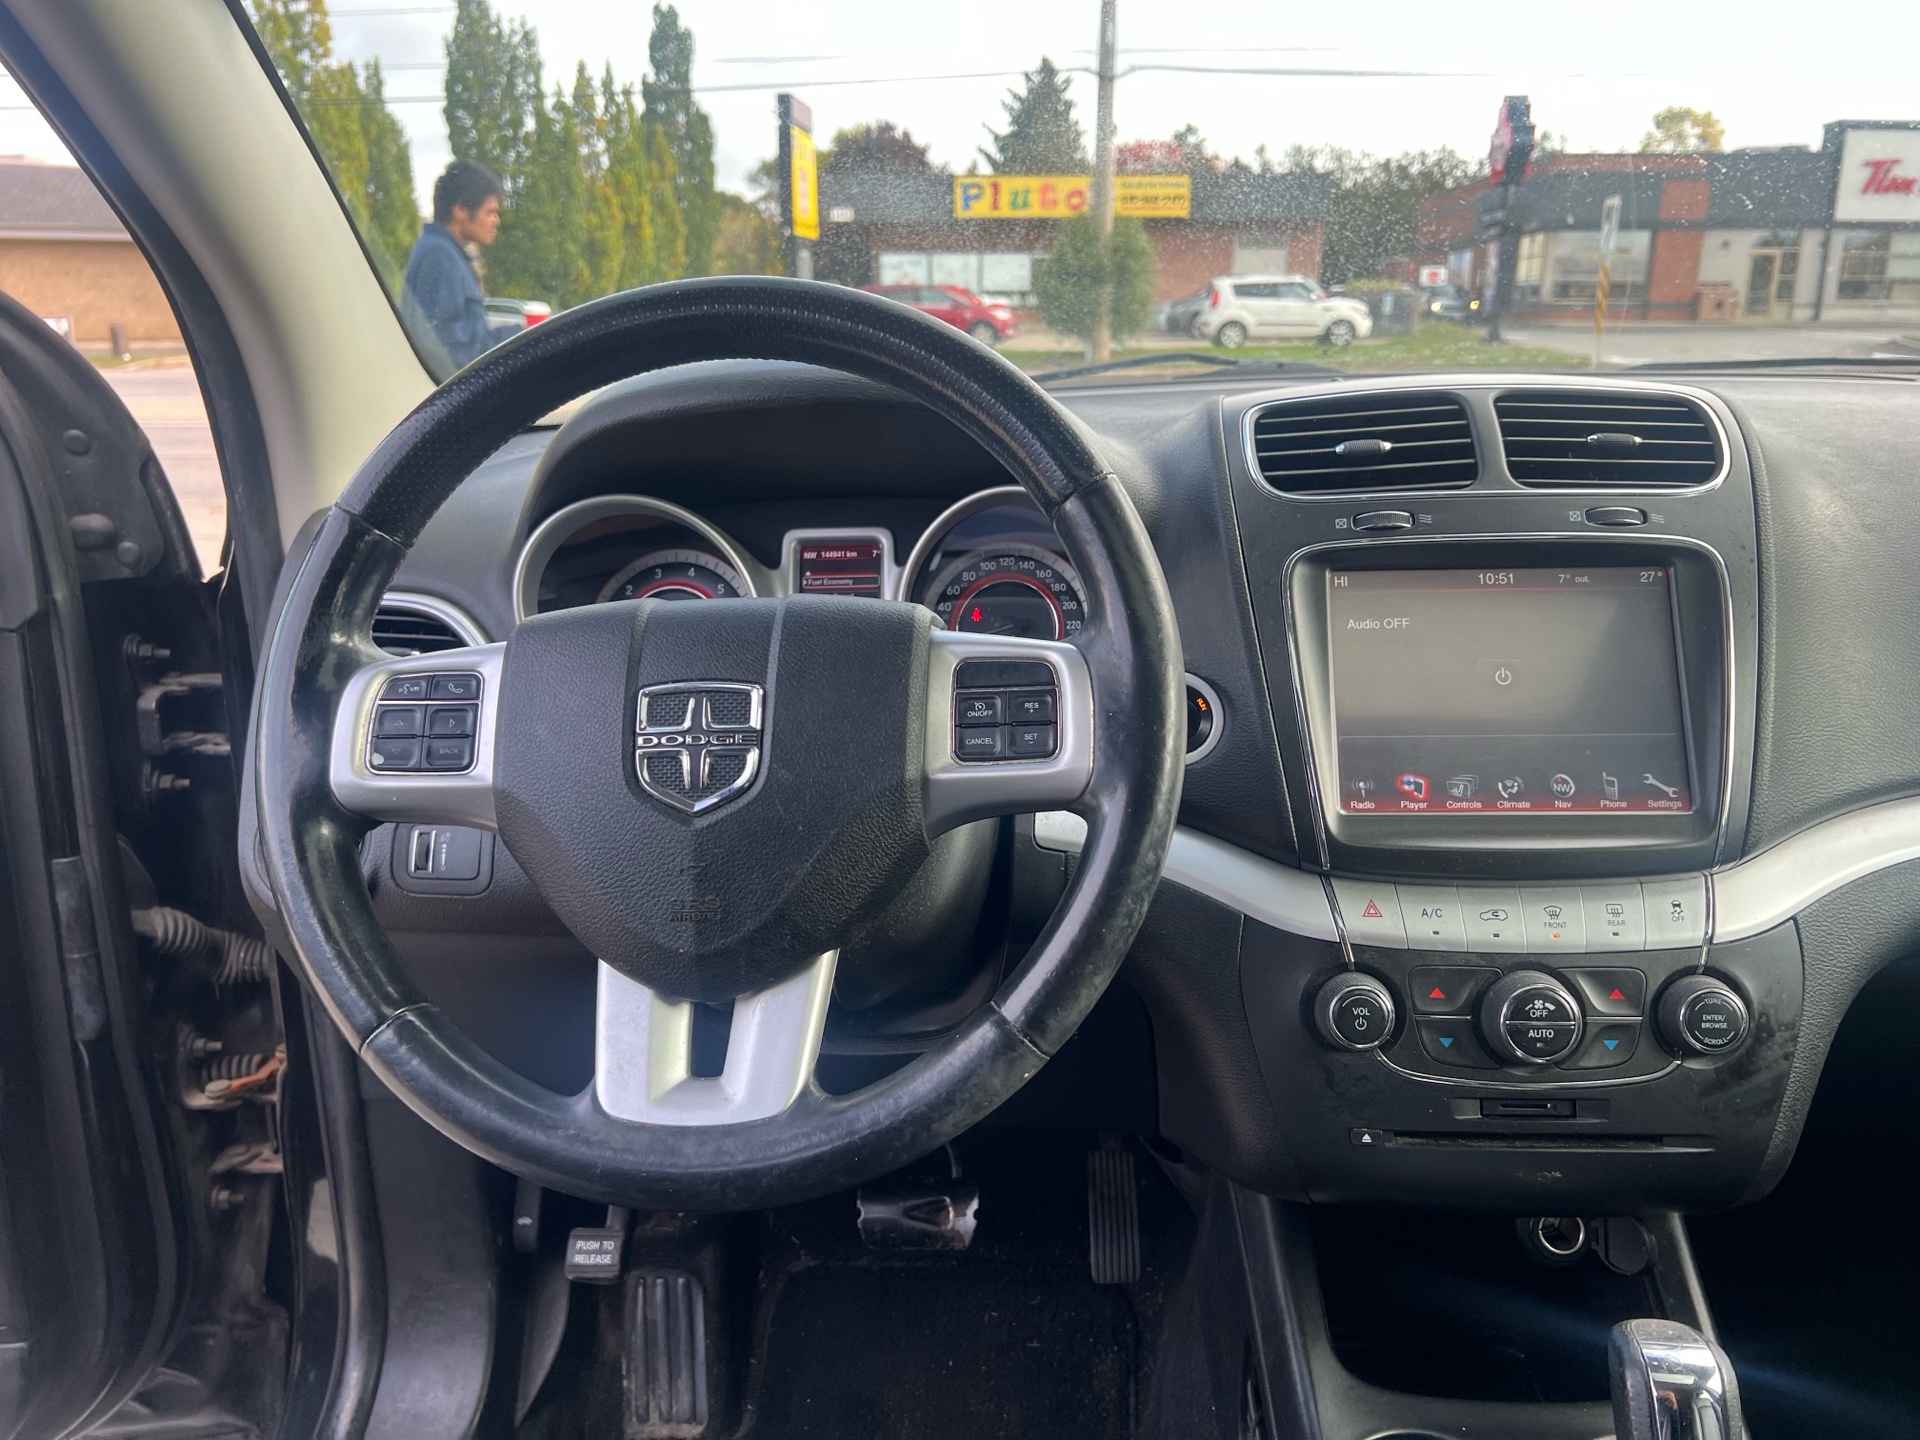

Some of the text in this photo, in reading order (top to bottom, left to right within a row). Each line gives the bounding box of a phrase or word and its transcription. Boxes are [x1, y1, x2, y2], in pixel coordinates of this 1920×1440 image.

[999, 557, 1015, 566] 120
[1018, 561, 1035, 570] 140
[979, 562, 997, 571] 100
[655, 569, 662, 578] 3
[687, 567, 696, 577] 4
[962, 572, 976, 581] 80
[1035, 569, 1052, 578] 160
[823, 578, 853, 586] Economy
[1334, 576, 1348, 587] HI
[1478, 573, 1514, 584] 10:51
[625, 585, 633, 595] 2
[717, 584, 725, 594] 5
[946, 587, 960, 596] 60
[1050, 583, 1067, 592] 180
[938, 602, 952, 612] 40
[1062, 601, 1077, 610] 200
[1066, 621, 1082, 629] 220
[1347, 617, 1410, 629] Audio OFF
[967, 709, 993, 717] ON/OFF
[637, 733, 757, 747] DODGE
[1553, 784, 1571, 793] NW
[1350, 801, 1375, 809] Radio
[1400, 801, 1428, 811] Player
[1446, 801, 1482, 809] Controls
[1497, 801, 1531, 809] Climate
[1647, 800, 1683, 810] Settings
[1421, 908, 1443, 920] A/C
[1704, 998, 1723, 1006] TUNE
[1352, 1007, 1371, 1016] VOL
[1529, 1009, 1549, 1018] OFF
[1702, 1014, 1726, 1022] ENTER/
[1528, 1029, 1554, 1038] AUTO
[1703, 1036, 1729, 1045] SCROLL
[575, 1240, 615, 1250] PUSH TO
[573, 1254, 613, 1264] RELEASE
